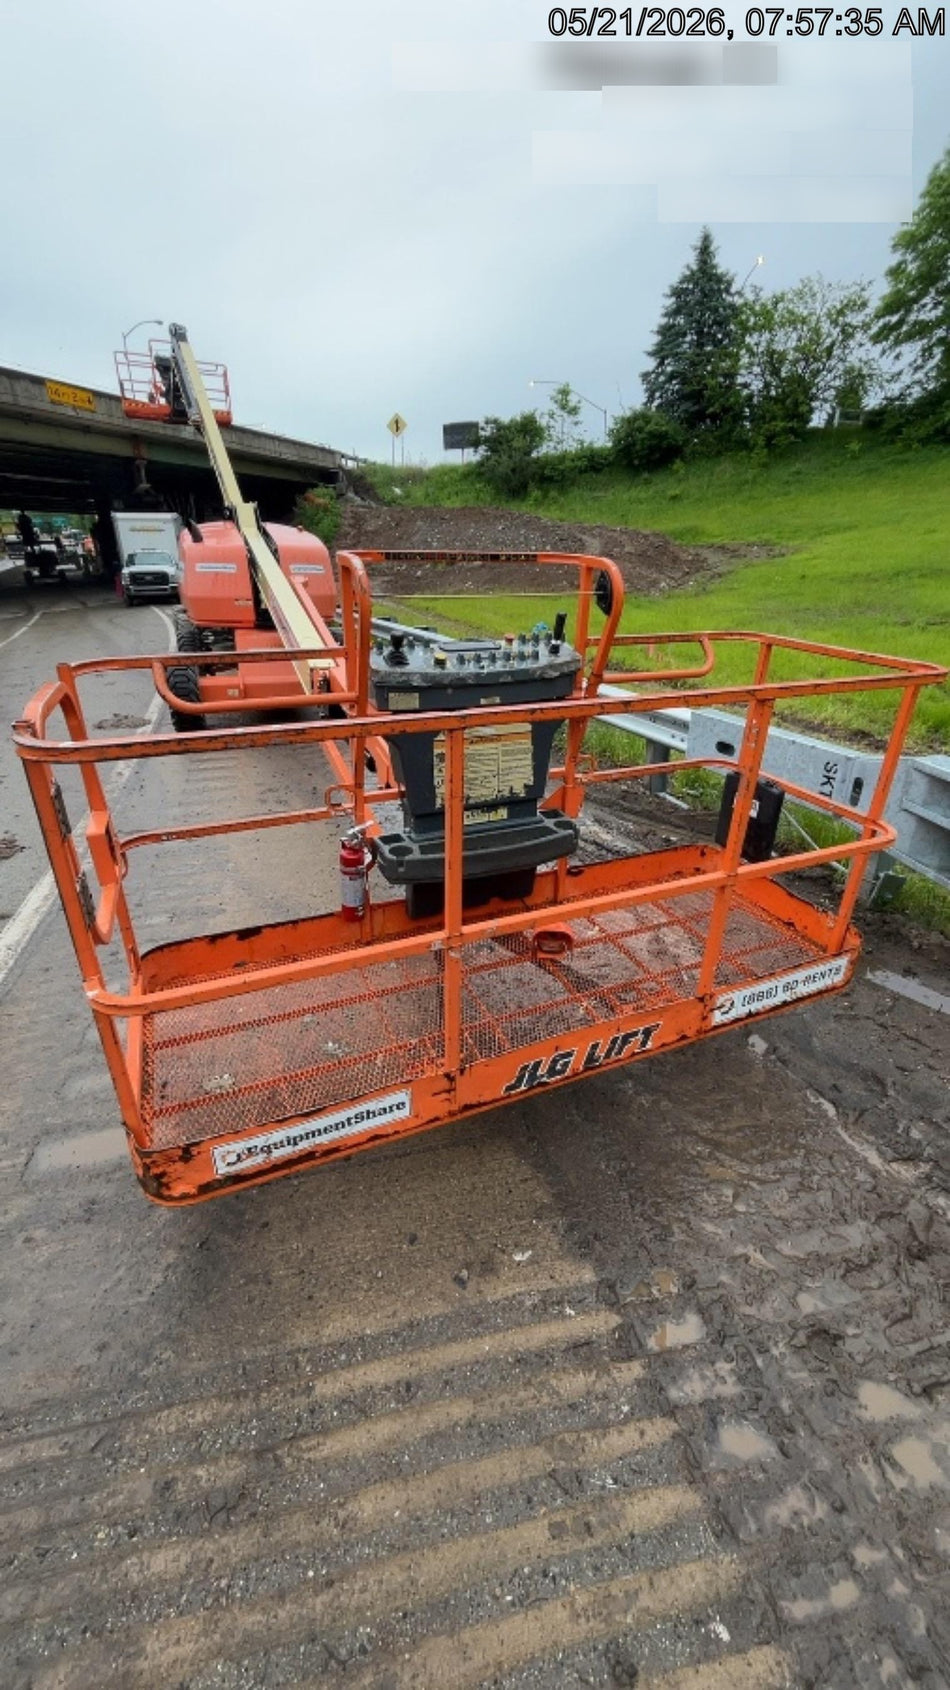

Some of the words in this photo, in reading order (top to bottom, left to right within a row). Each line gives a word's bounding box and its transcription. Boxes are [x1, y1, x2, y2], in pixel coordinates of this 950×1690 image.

[501, 1048, 578, 1096] JLG
[579, 1021, 663, 1072] LIFT
[245, 1100, 407, 1158] EquipmentShare
